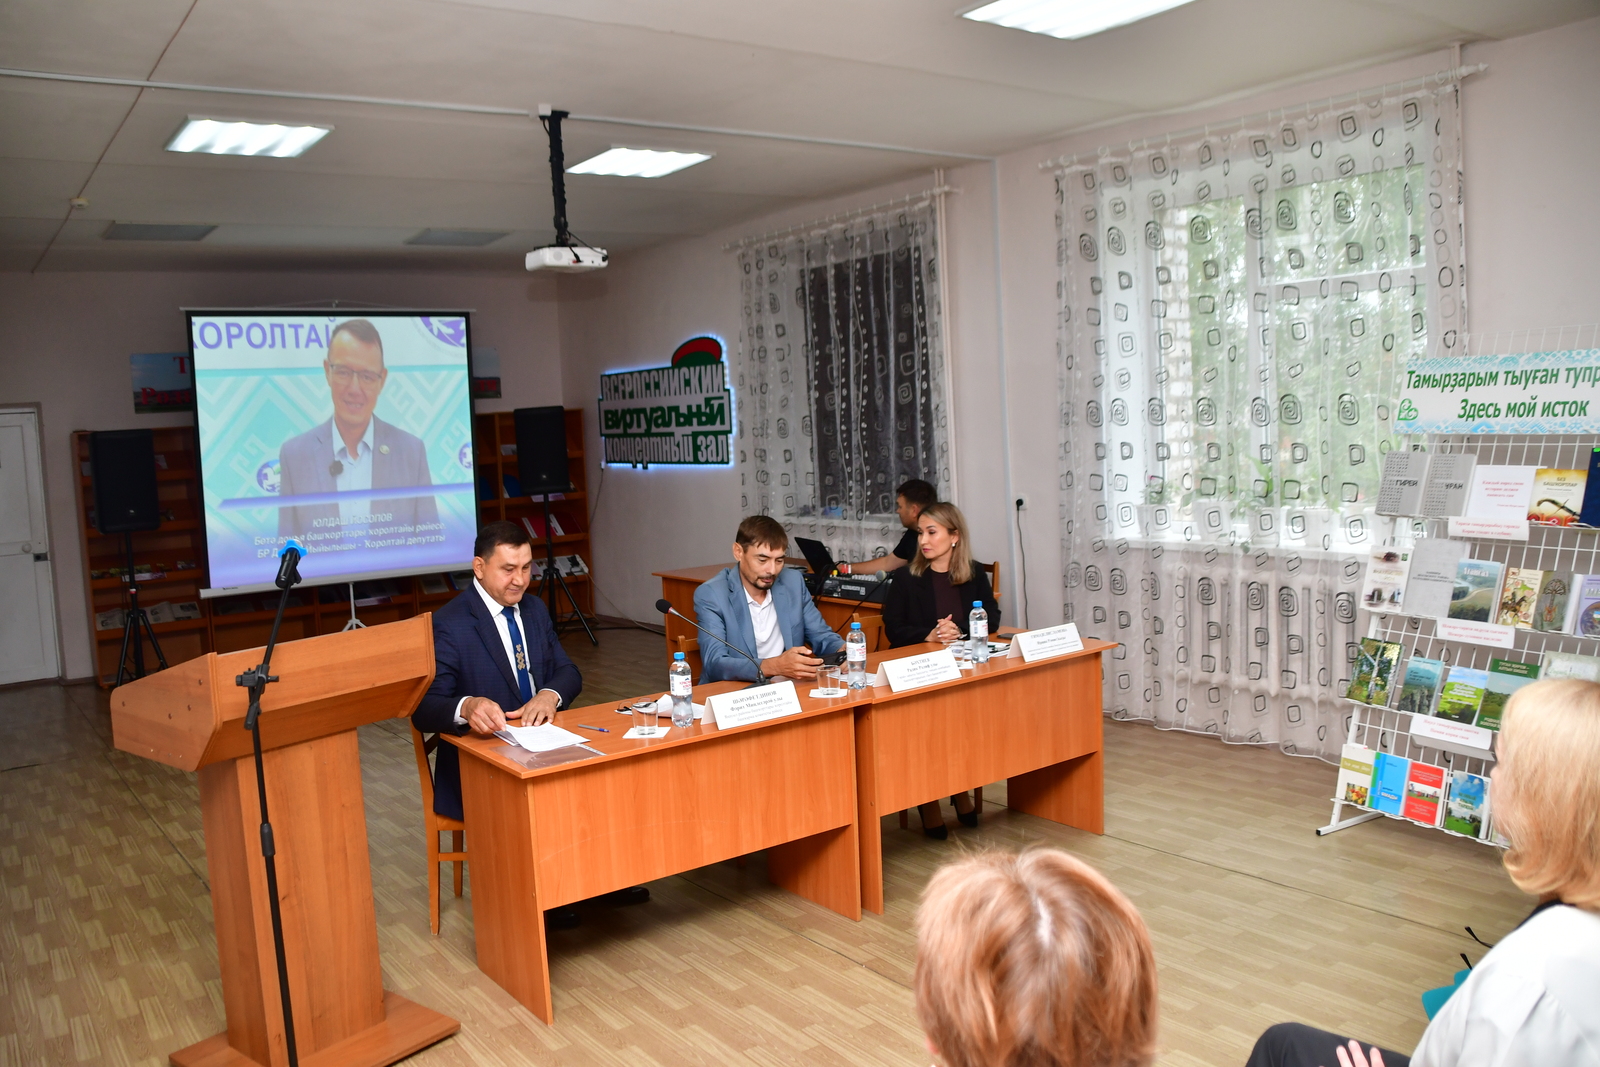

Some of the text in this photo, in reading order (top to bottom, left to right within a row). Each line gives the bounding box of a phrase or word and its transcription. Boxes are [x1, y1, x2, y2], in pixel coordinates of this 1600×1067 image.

[1503, 368, 1560, 390] тыуған
[1457, 395, 1590, 421] Здесь мой исток
[697, 434, 728, 463] зал
[313, 516, 348, 528] ЮЛДАШ
[257, 548, 270, 558] БР
[406, 534, 446, 546] депутаты
